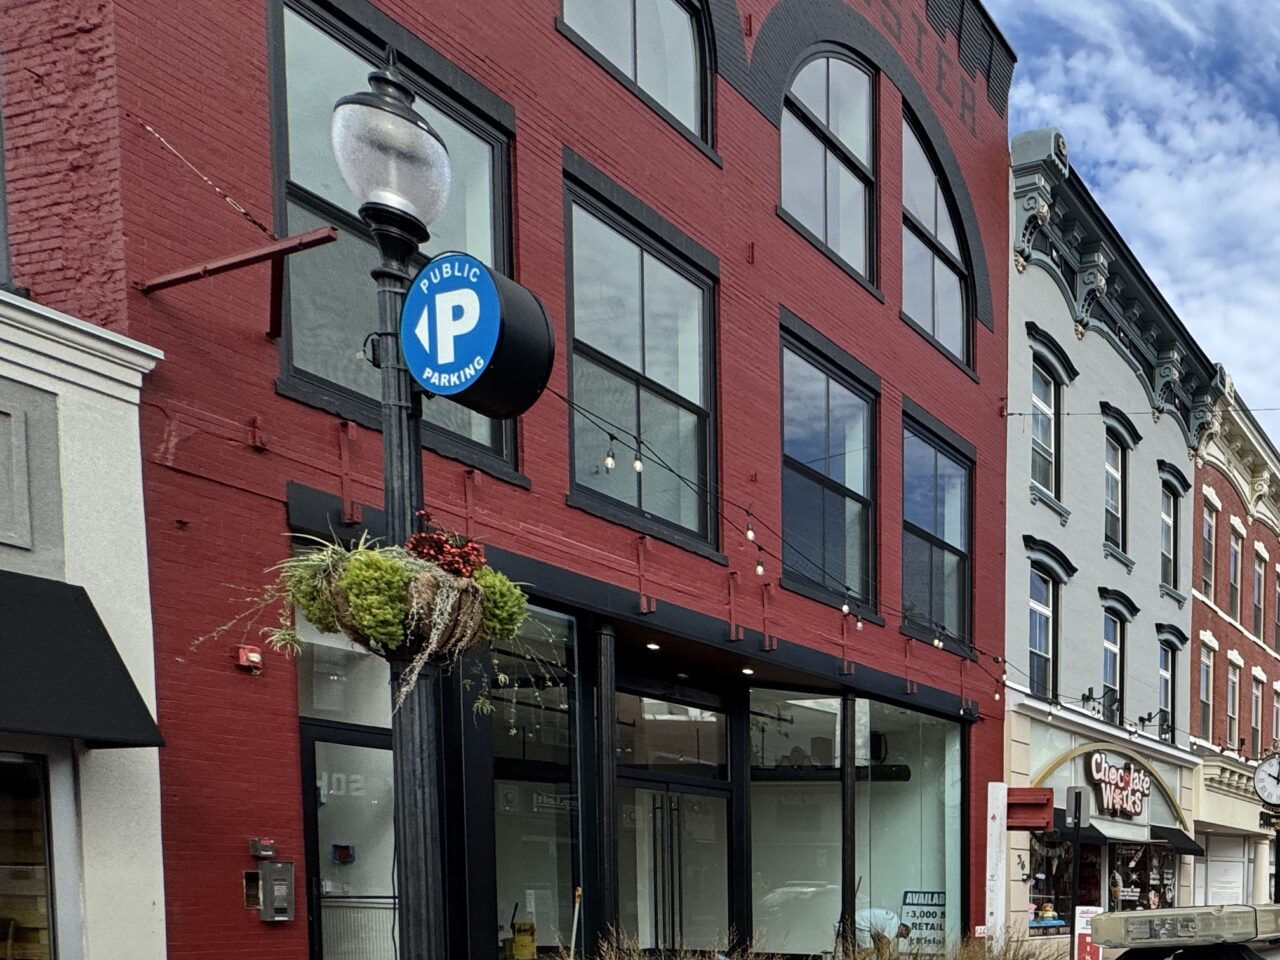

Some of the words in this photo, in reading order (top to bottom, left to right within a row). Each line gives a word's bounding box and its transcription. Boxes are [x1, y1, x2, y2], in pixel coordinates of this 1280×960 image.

[419, 262, 480, 294] PUBLIC
[435, 288, 480, 365] P
[422, 356, 485, 387] PARKING
[1091, 753, 1151, 795] Chocolate
[1101, 782, 1142, 813] Works
[911, 922, 945, 931] RETAIL
